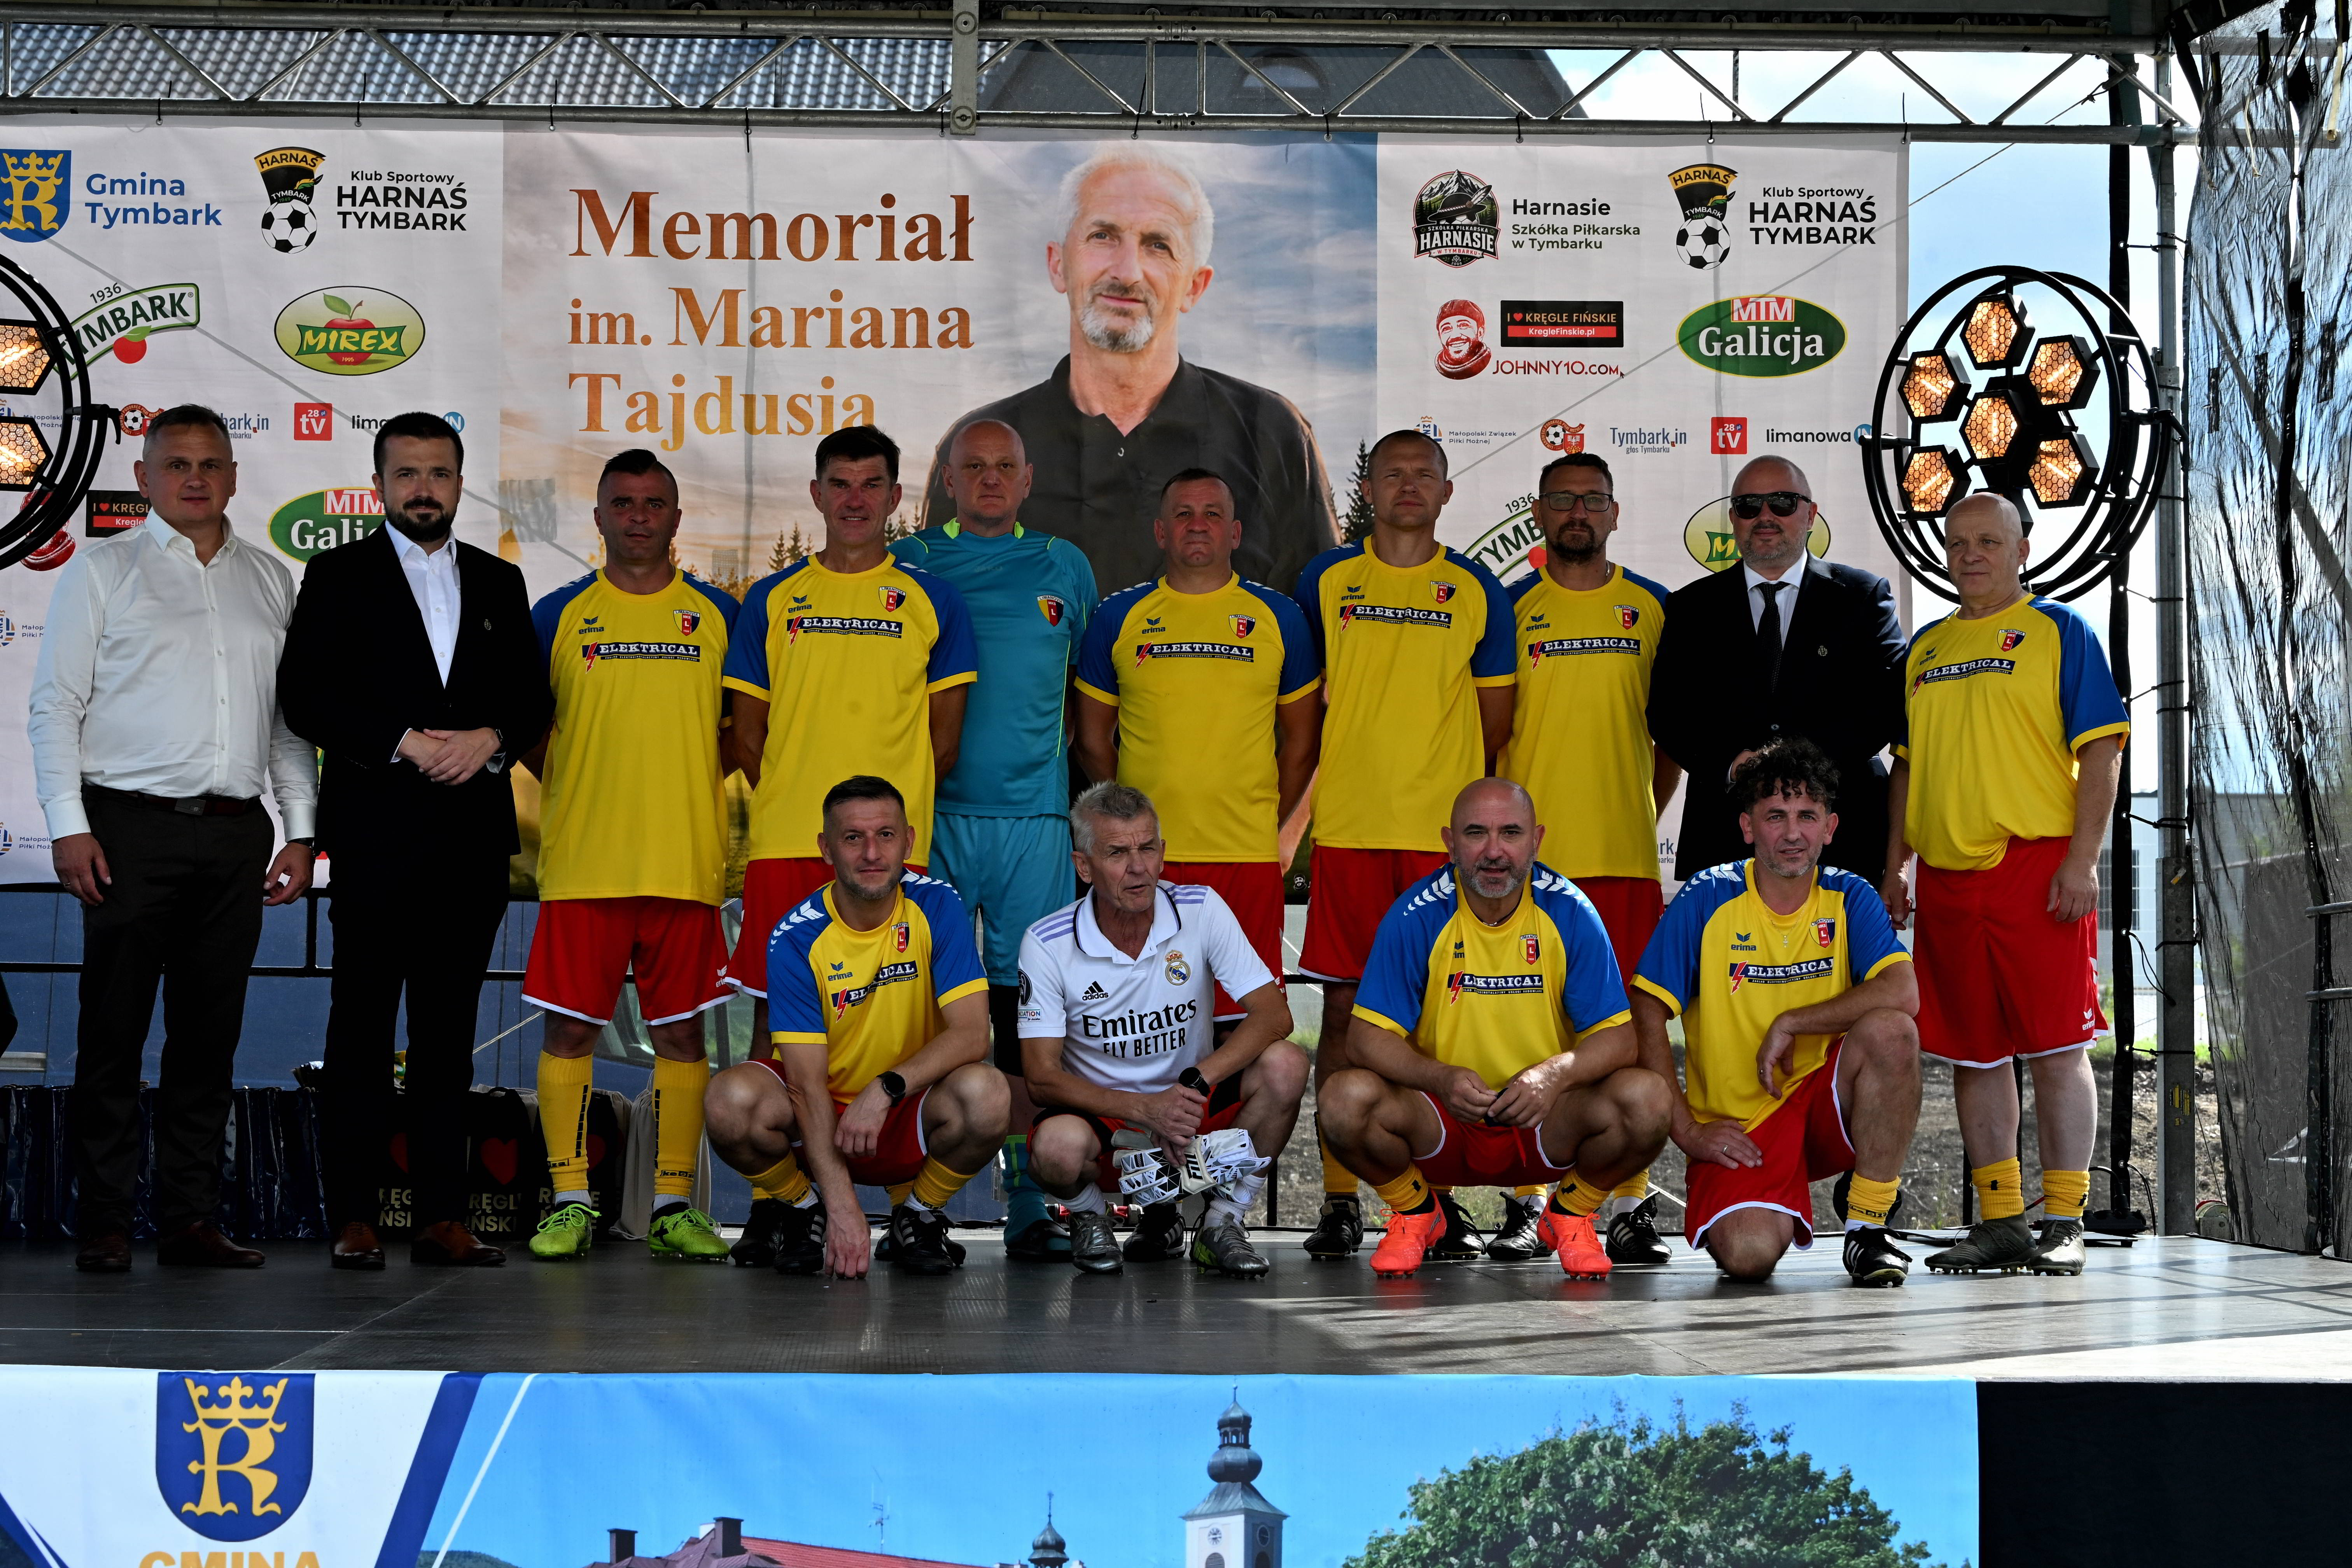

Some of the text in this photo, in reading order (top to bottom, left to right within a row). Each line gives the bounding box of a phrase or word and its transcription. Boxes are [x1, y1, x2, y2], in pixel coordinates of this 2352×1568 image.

[258, 153, 318, 169] HARNAŚ
[86, 172, 186, 196] Gmina
[351, 171, 455, 185] Klub Sportowy
[1673, 170, 1731, 186] HARNAŚ
[271, 191, 310, 201] TYMBARK
[337, 182, 467, 209] HARNAŚ
[1763, 187, 1864, 199] Klub Sportowy
[85, 201, 222, 229] Tymbark
[1513, 198, 1611, 216] Harnasie
[1685, 206, 1722, 218] TYMBARK
[1750, 196, 1876, 223] HARNAŚ
[337, 212, 467, 231] TYMBARK
[569, 189, 974, 262] Memoriał
[1512, 224, 1640, 235] Szkółka Piłkarska
[1420, 231, 1494, 252] HARNASIE
[1750, 227, 1876, 245] TYMBARK
[1512, 238, 1602, 251] w Tymbarku
[90, 283, 121, 303] 1936
[1733, 297, 1792, 320] MTM
[568, 287, 975, 349] im. Mariana
[1526, 313, 1569, 324] KRĘGLE
[1573, 311, 1616, 322] FIŃSKIE
[303, 329, 398, 352] MIREX
[1529, 328, 1595, 338] KregleFinskie.pl
[1699, 326, 1825, 365] Galicja
[569, 373, 875, 451] Tajdusia
[300, 414, 326, 435] tv
[1610, 427, 1687, 447] Tymbark.in
[1717, 428, 1741, 448] tv
[1766, 429, 1851, 443] limanowa
[1626, 446, 1670, 454] głos Tymbarku
[113, 503, 149, 515] KRĘGL
[327, 490, 386, 513] MTM
[1505, 493, 1535, 513] 1936
[881, 586, 904, 594] LIMANOVIA
[1040, 595, 1063, 604] LIMANOVIA
[788, 604, 812, 613] erima
[1356, 606, 1448, 622] ELEKTRICAL
[579, 626, 604, 634] erima
[803, 618, 899, 632] ELEKTRICAL
[1526, 623, 1550, 632] erima
[600, 644, 697, 655] ELEKTRICAL
[1152, 644, 1251, 656] ELEKTRICAL
[1544, 639, 1637, 651] ELEKTRICAL
[1920, 654, 1937, 666] erima
[1925, 659, 2011, 678] ELEKTRICAL
[1811, 918, 1833, 926] LIMANOVIA
[828, 971, 853, 981] erima
[1082, 992, 1109, 1001] adidas
[1082, 999, 1197, 1038] Emirates
[1103, 1027, 1185, 1059] FLY BETTER
